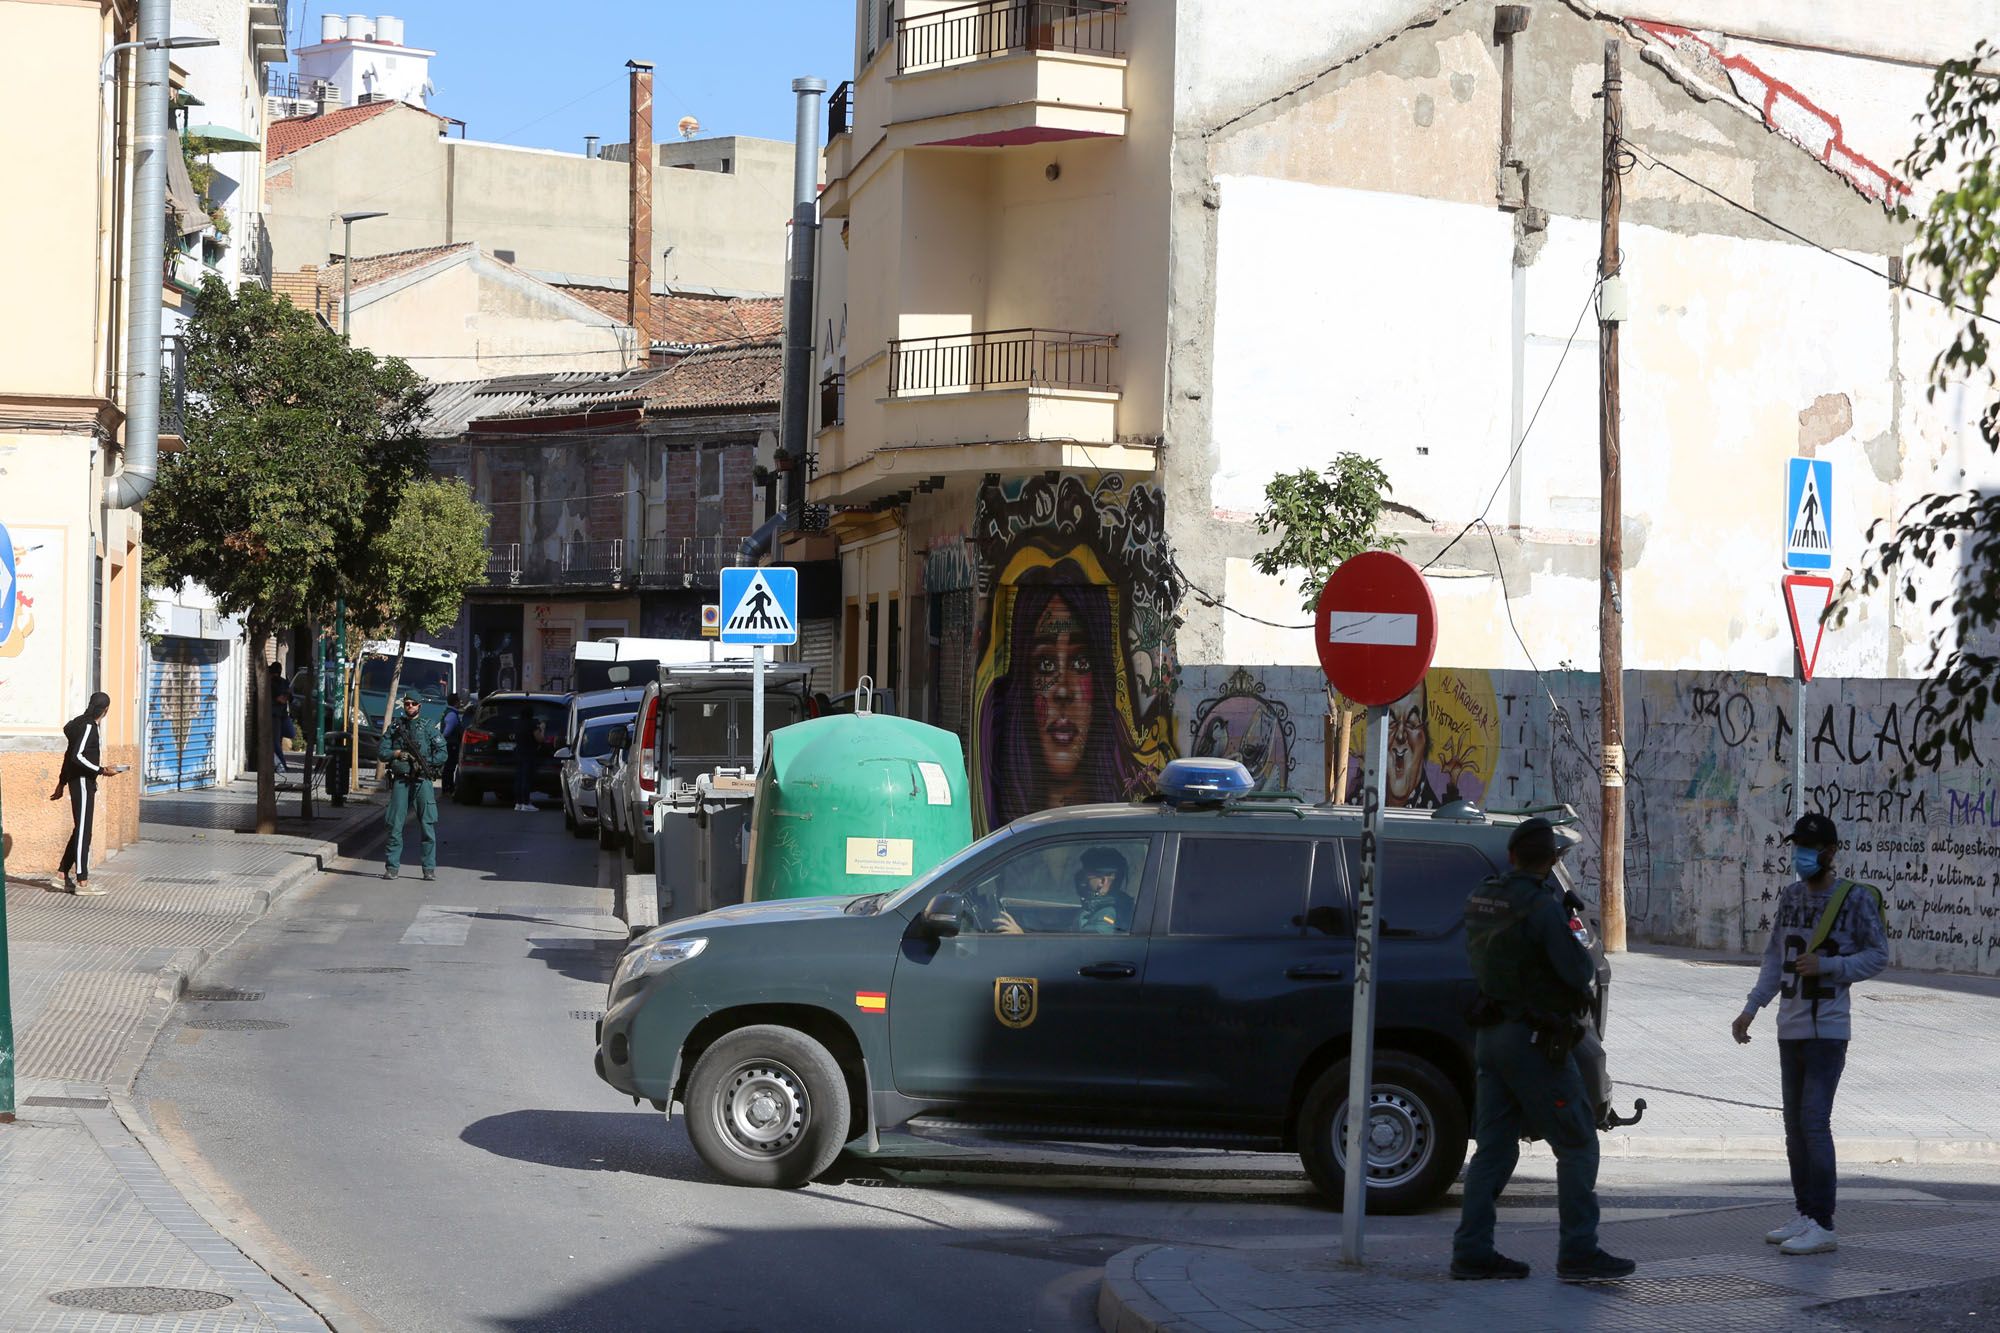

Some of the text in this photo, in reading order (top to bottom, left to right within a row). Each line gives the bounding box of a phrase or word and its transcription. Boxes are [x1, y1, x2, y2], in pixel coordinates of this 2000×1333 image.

[1876, 837, 1926, 862] espacios
[1937, 863, 1986, 887] última
[1923, 895, 1974, 921] pulmón
[1907, 915, 1969, 948] horizonte,
[1972, 927, 1984, 946] el
